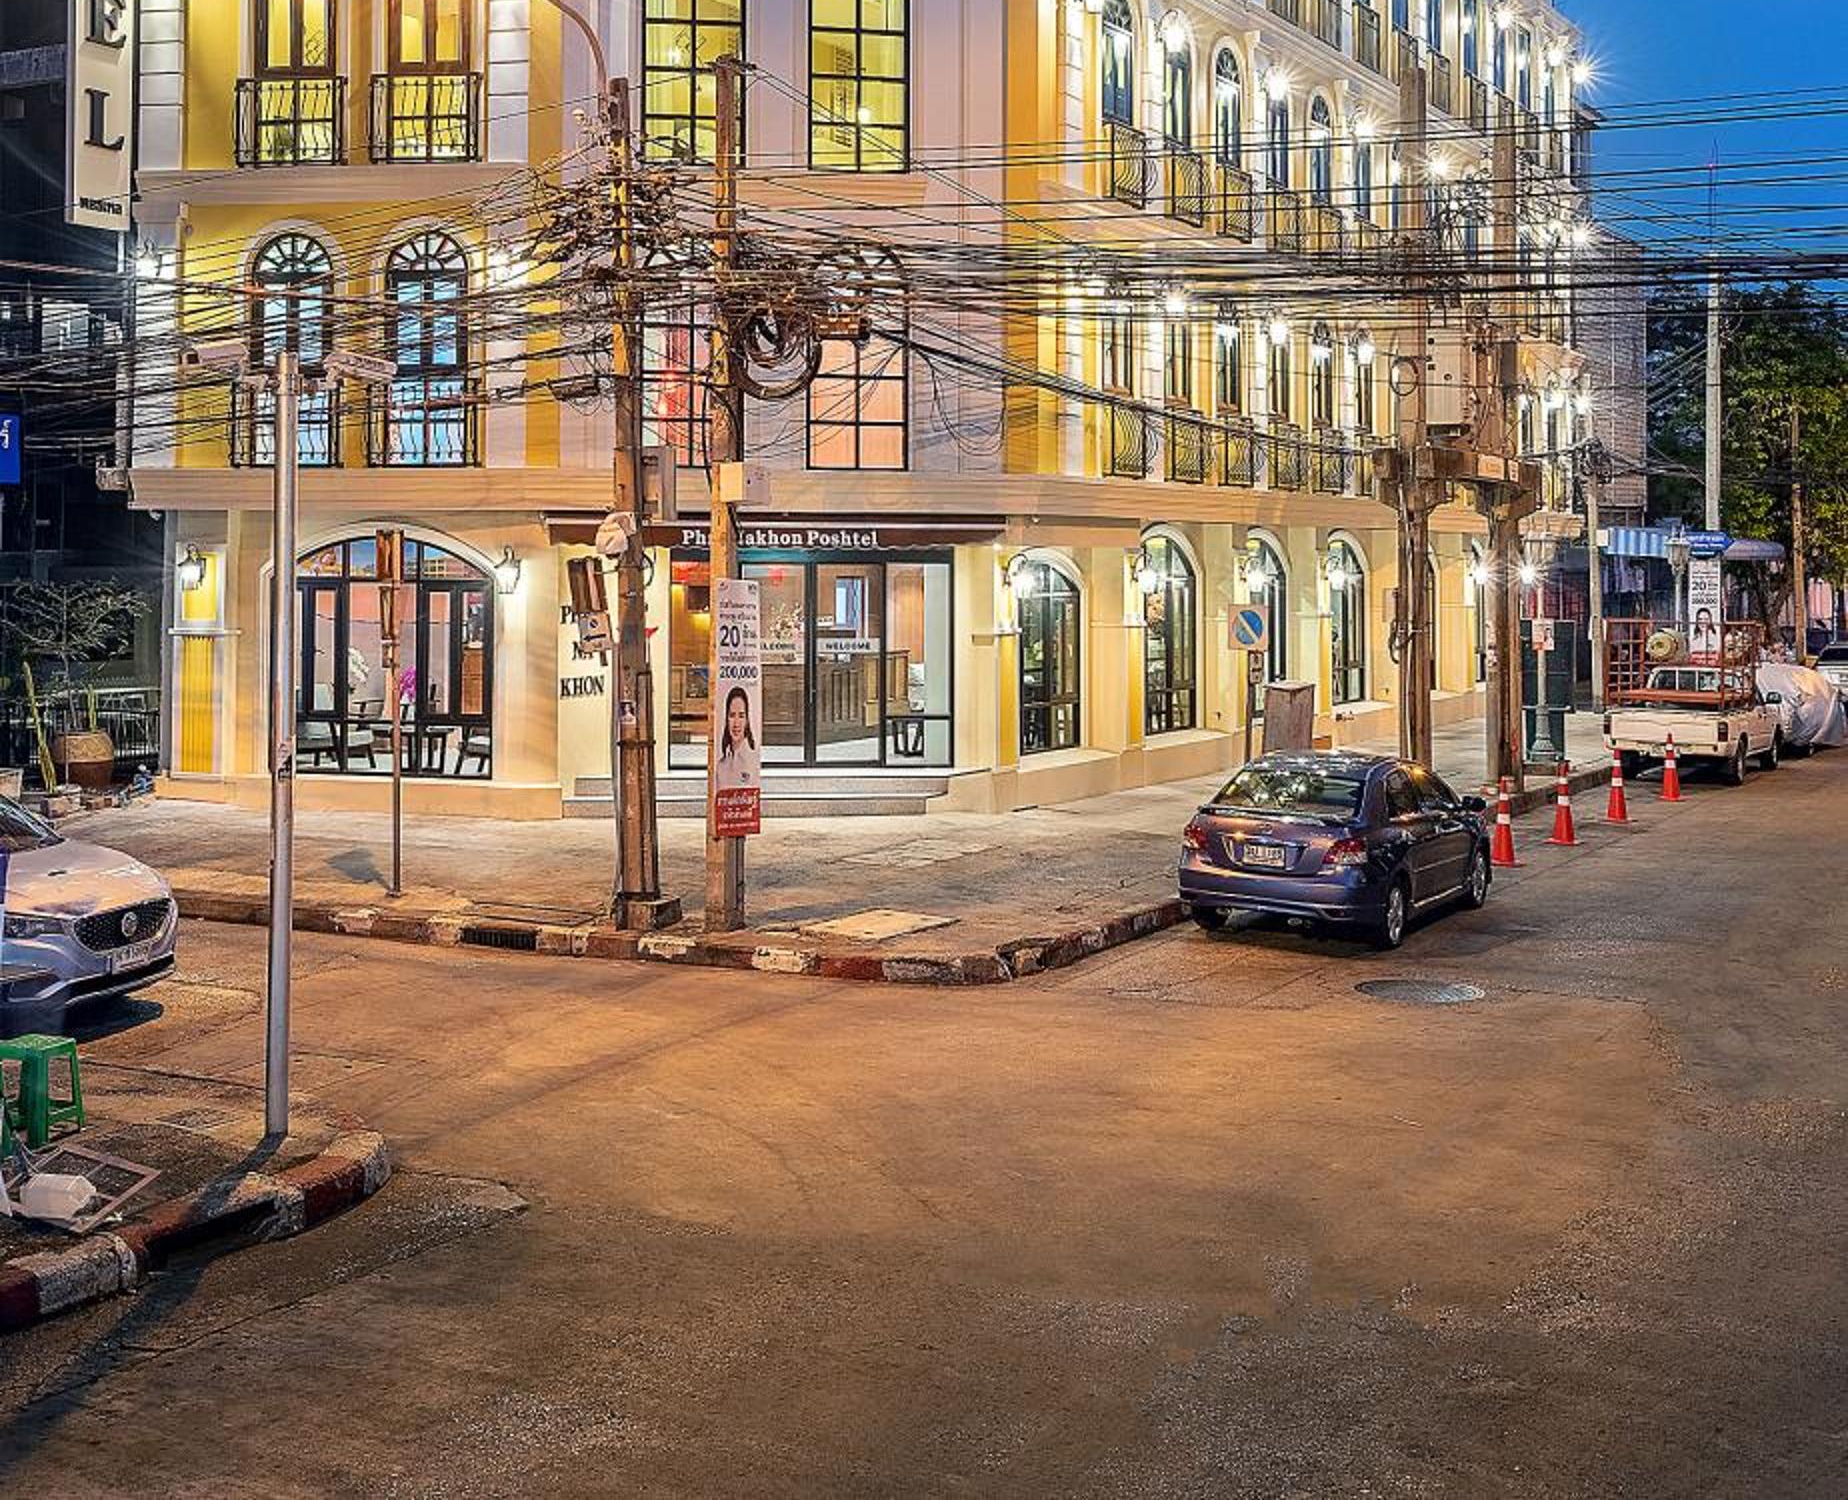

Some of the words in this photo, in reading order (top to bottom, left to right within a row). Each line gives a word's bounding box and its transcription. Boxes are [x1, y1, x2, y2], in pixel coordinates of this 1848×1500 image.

[806, 530, 878, 546] Poshtel
[720, 625, 740, 648] 20
[560, 675, 605, 698] KHON
